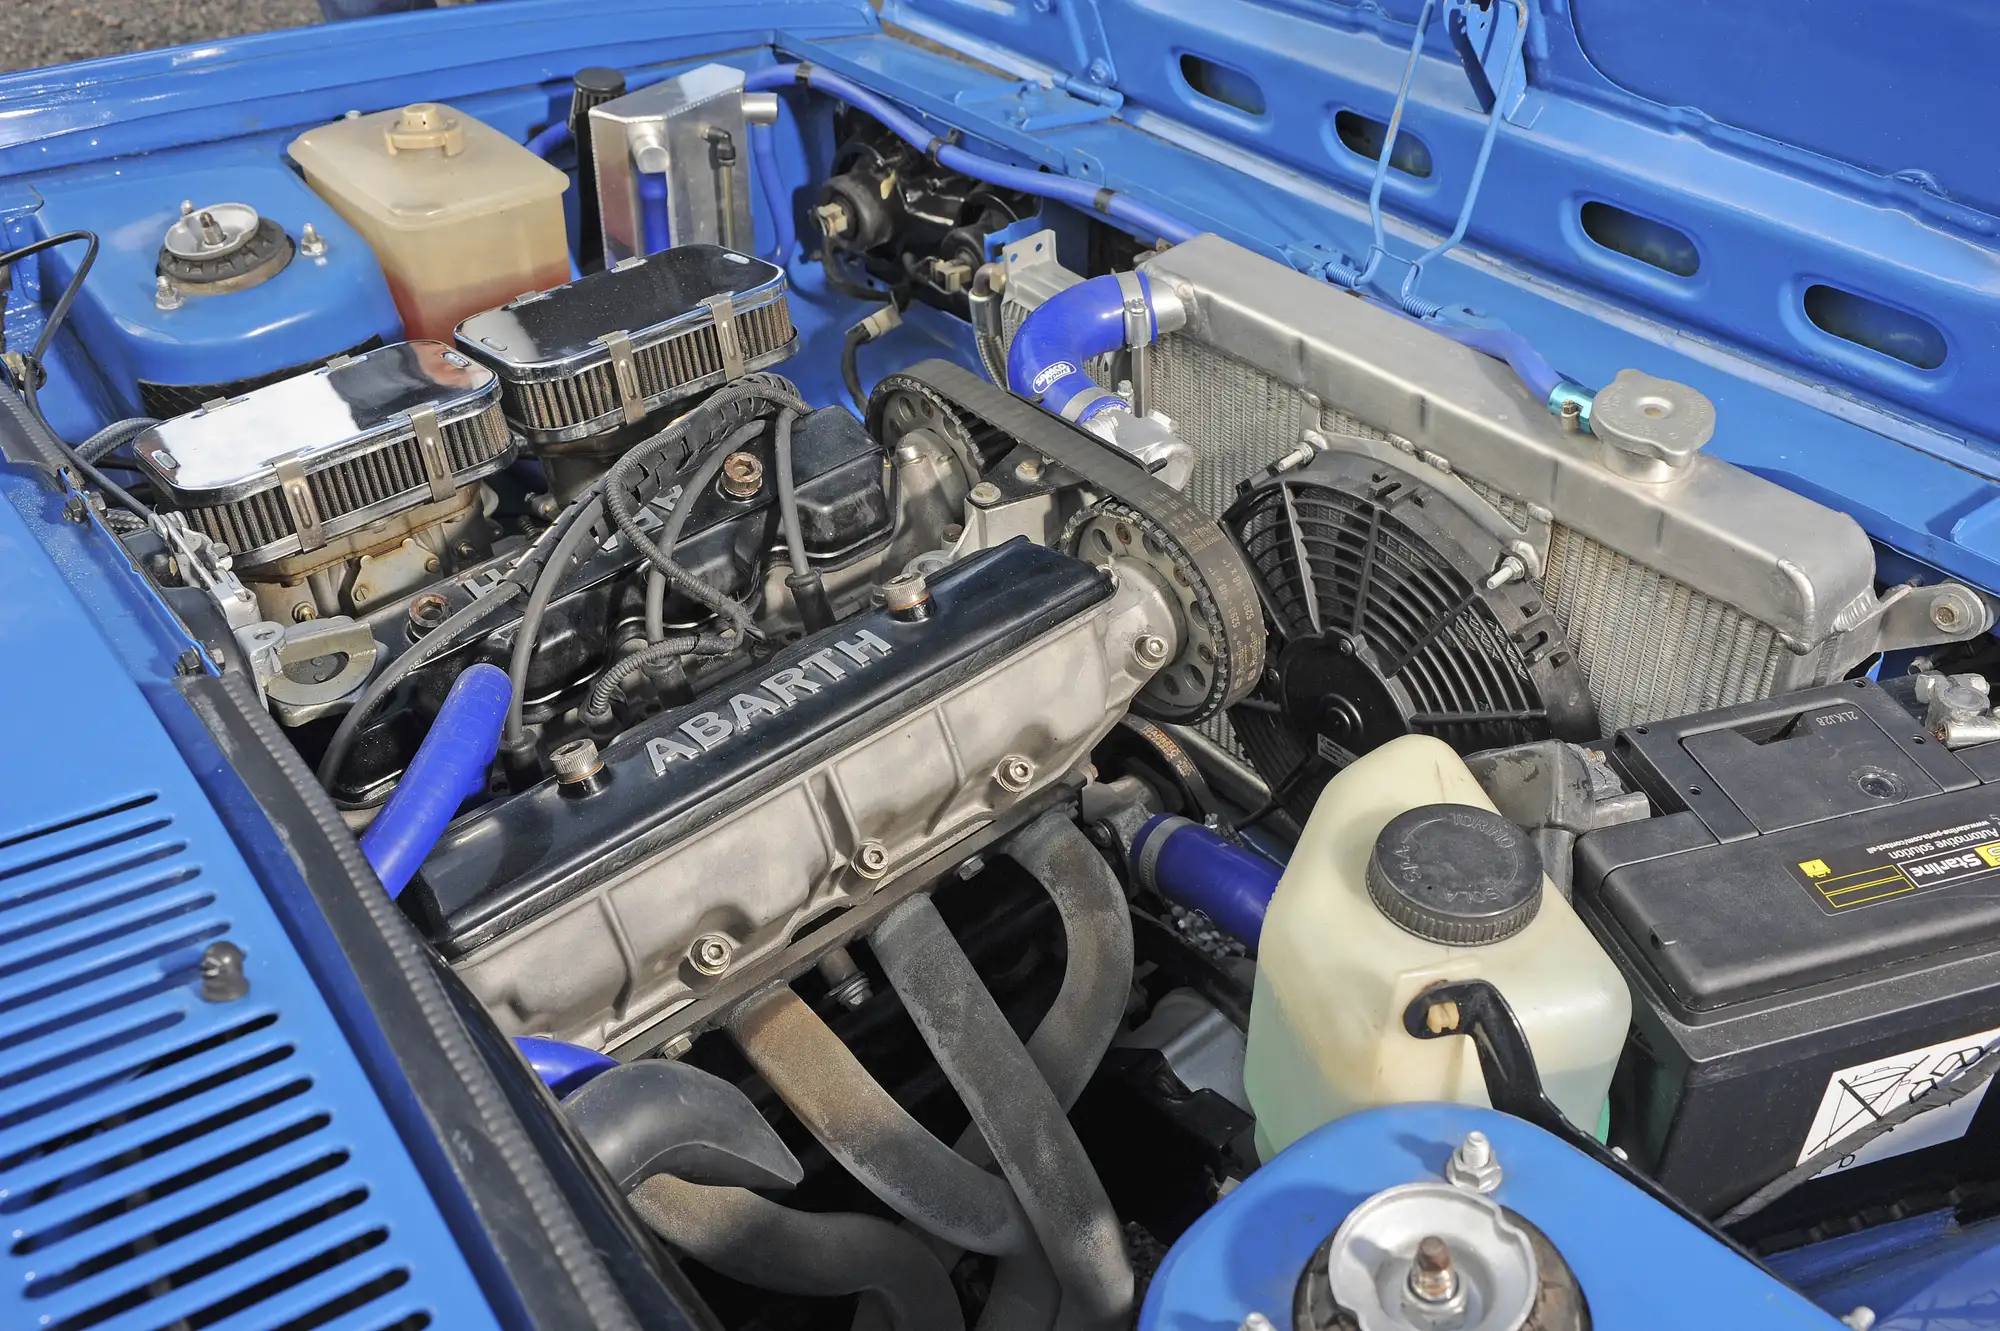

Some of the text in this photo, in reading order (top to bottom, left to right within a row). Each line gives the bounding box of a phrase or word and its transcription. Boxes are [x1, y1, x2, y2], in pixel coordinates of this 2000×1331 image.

[645, 629, 893, 776] ABARTH
[1815, 710, 1859, 727] 2LKJ28
[1888, 827, 1999, 860] Automotive solution
[1908, 853, 1982, 878] Starline
